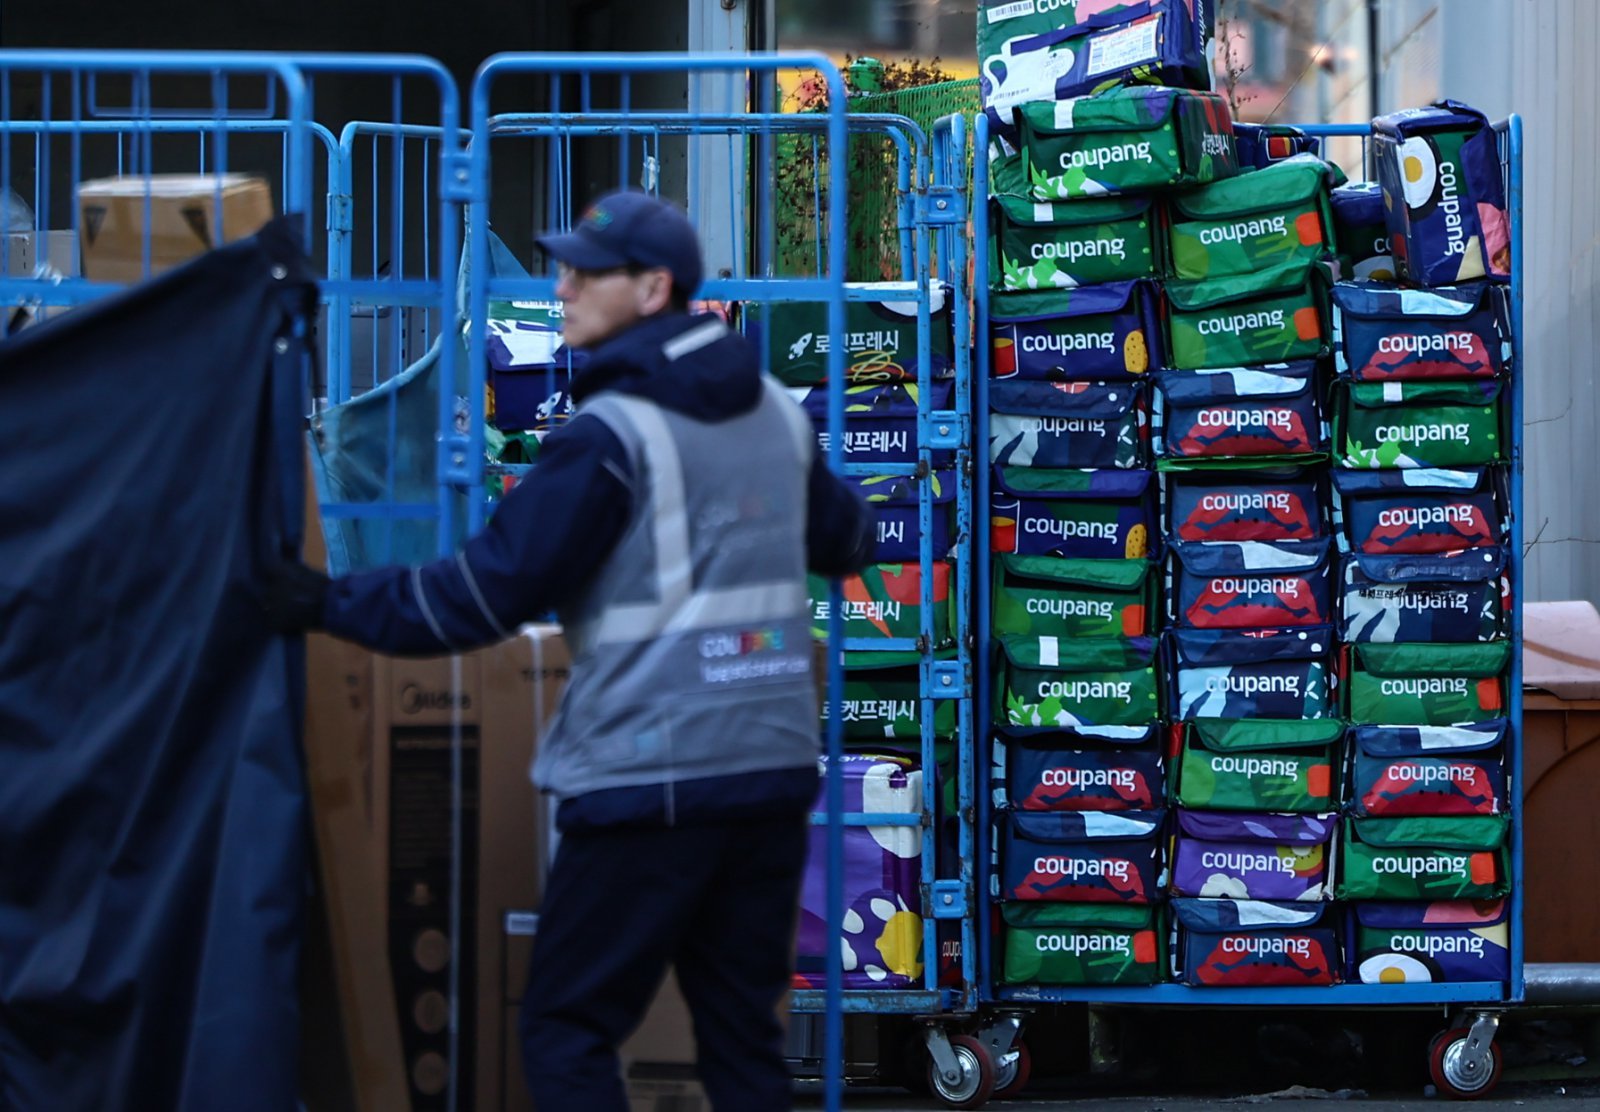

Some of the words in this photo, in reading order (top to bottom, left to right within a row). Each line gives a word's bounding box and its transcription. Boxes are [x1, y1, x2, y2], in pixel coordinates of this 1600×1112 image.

[1059, 141, 1152, 170] coupang
[1438, 161, 1465, 256] coupang
[1200, 215, 1287, 246] coupang
[1031, 238, 1125, 262] coupang
[1198, 309, 1285, 336] coupang
[1022, 331, 1115, 355] coupang
[1378, 333, 1472, 357] coupang
[1020, 416, 1106, 437] coupang
[1197, 409, 1292, 432] coupang
[1375, 423, 1470, 447] coupang
[1203, 492, 1290, 514] coupang
[1378, 505, 1473, 529] coupang
[1024, 517, 1119, 543] coupang
[1211, 577, 1298, 599] coupang
[1026, 597, 1113, 621] coupang
[1038, 680, 1131, 703] coupang
[1206, 673, 1299, 698] coupang
[1381, 677, 1468, 697] coupang
[1041, 768, 1136, 791] coupang
[1211, 756, 1298, 781] coupang
[1388, 764, 1475, 786] coupang
[1034, 856, 1129, 882] coupang
[1202, 851, 1296, 878] coupang
[1372, 856, 1467, 878] coupang
[1036, 933, 1130, 956] coupang
[1222, 935, 1310, 958] coupang
[1390, 934, 1484, 958] coupang
